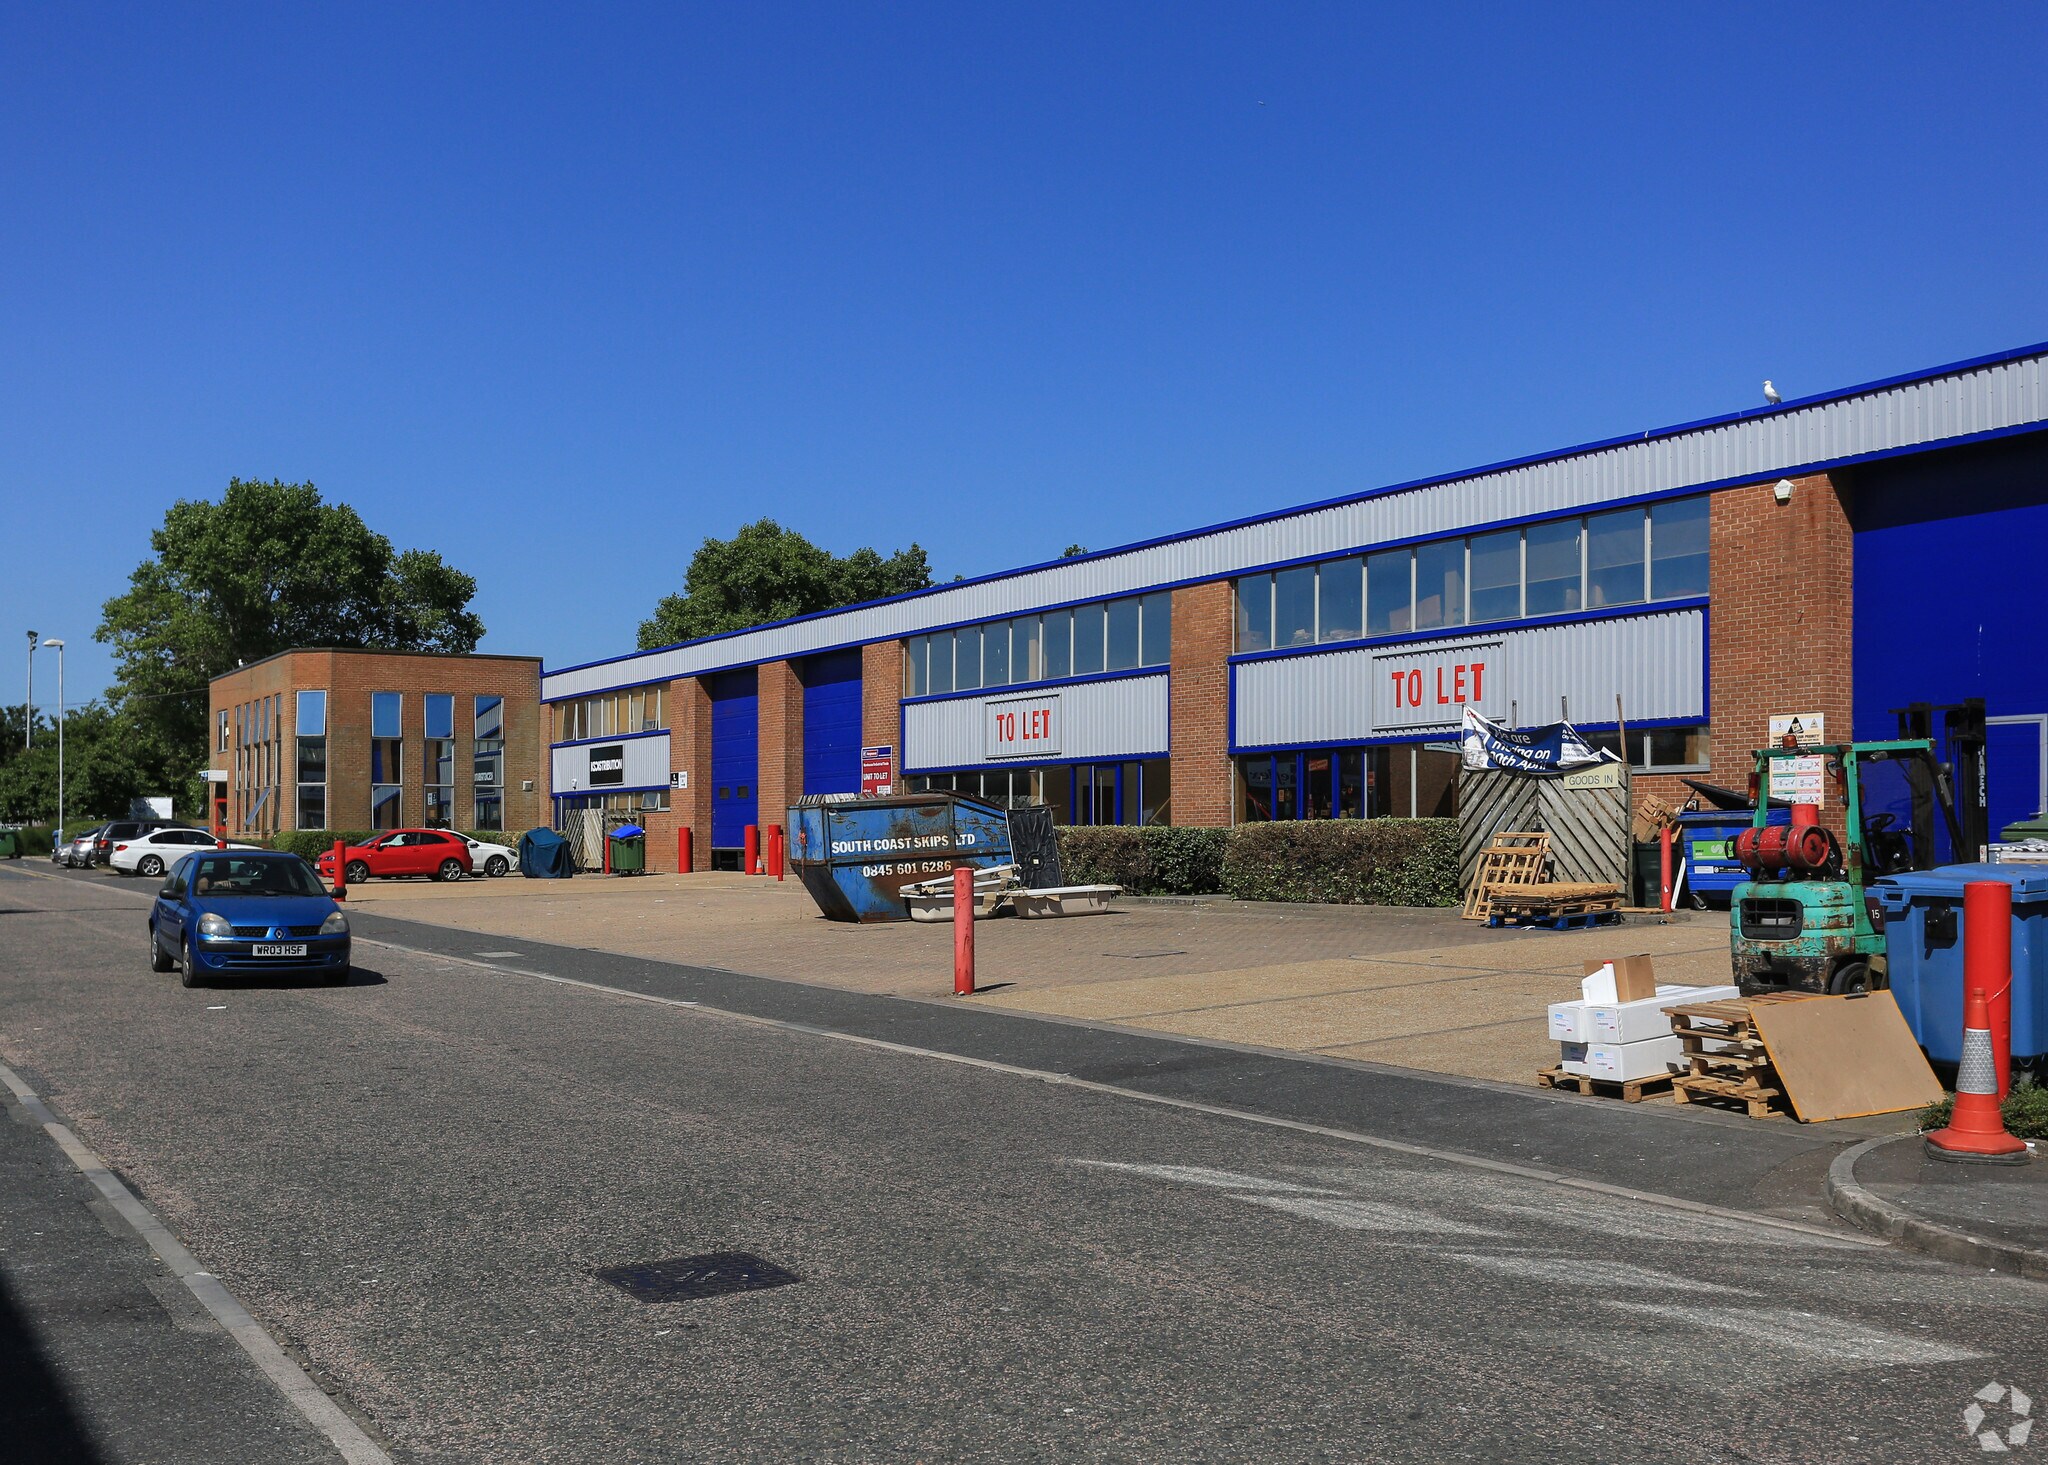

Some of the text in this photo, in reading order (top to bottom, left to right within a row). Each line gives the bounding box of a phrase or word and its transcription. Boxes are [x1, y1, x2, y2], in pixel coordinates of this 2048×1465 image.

[1392, 663, 1485, 708] TO LET
[996, 709, 1050, 742] TO LET
[1510, 733, 1531, 744] are
[1535, 748, 1551, 760] on
[873, 772, 880, 780] TO
[880, 772, 888, 780] LET
[1569, 774, 1613, 785] GOODS IN
[832, 833, 976, 854] SOUTH COAST SKIPS LTD
[863, 860, 952, 877] 0845 601 6286
[1872, 909, 1880, 919] 15
[257, 946, 303, 955] WR03 HSF
